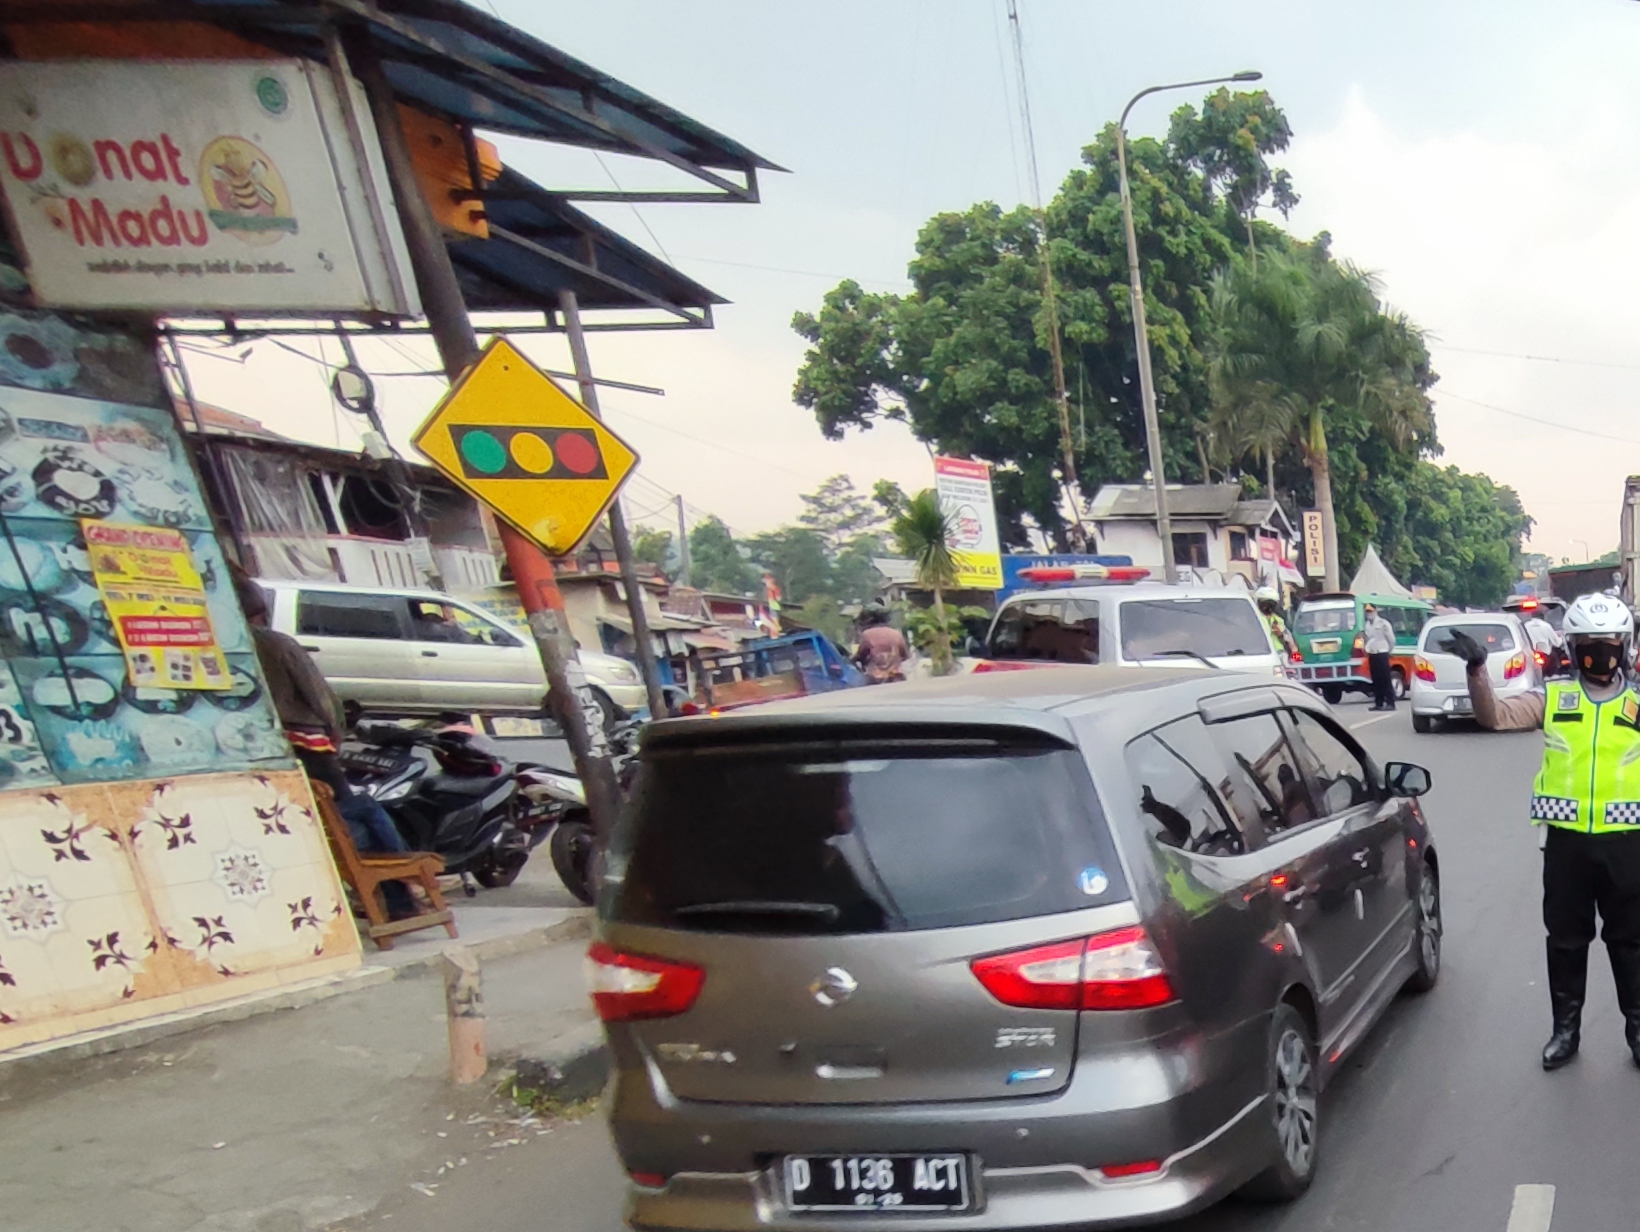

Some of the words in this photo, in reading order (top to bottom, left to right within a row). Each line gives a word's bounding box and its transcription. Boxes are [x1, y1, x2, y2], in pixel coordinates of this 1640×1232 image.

[67, 195, 208, 247] Madu
[1308, 515, 1319, 564] POLISI
[792, 1158, 811, 1190] D
[831, 1158, 894, 1190] 1136
[913, 1158, 961, 1191] ACT
